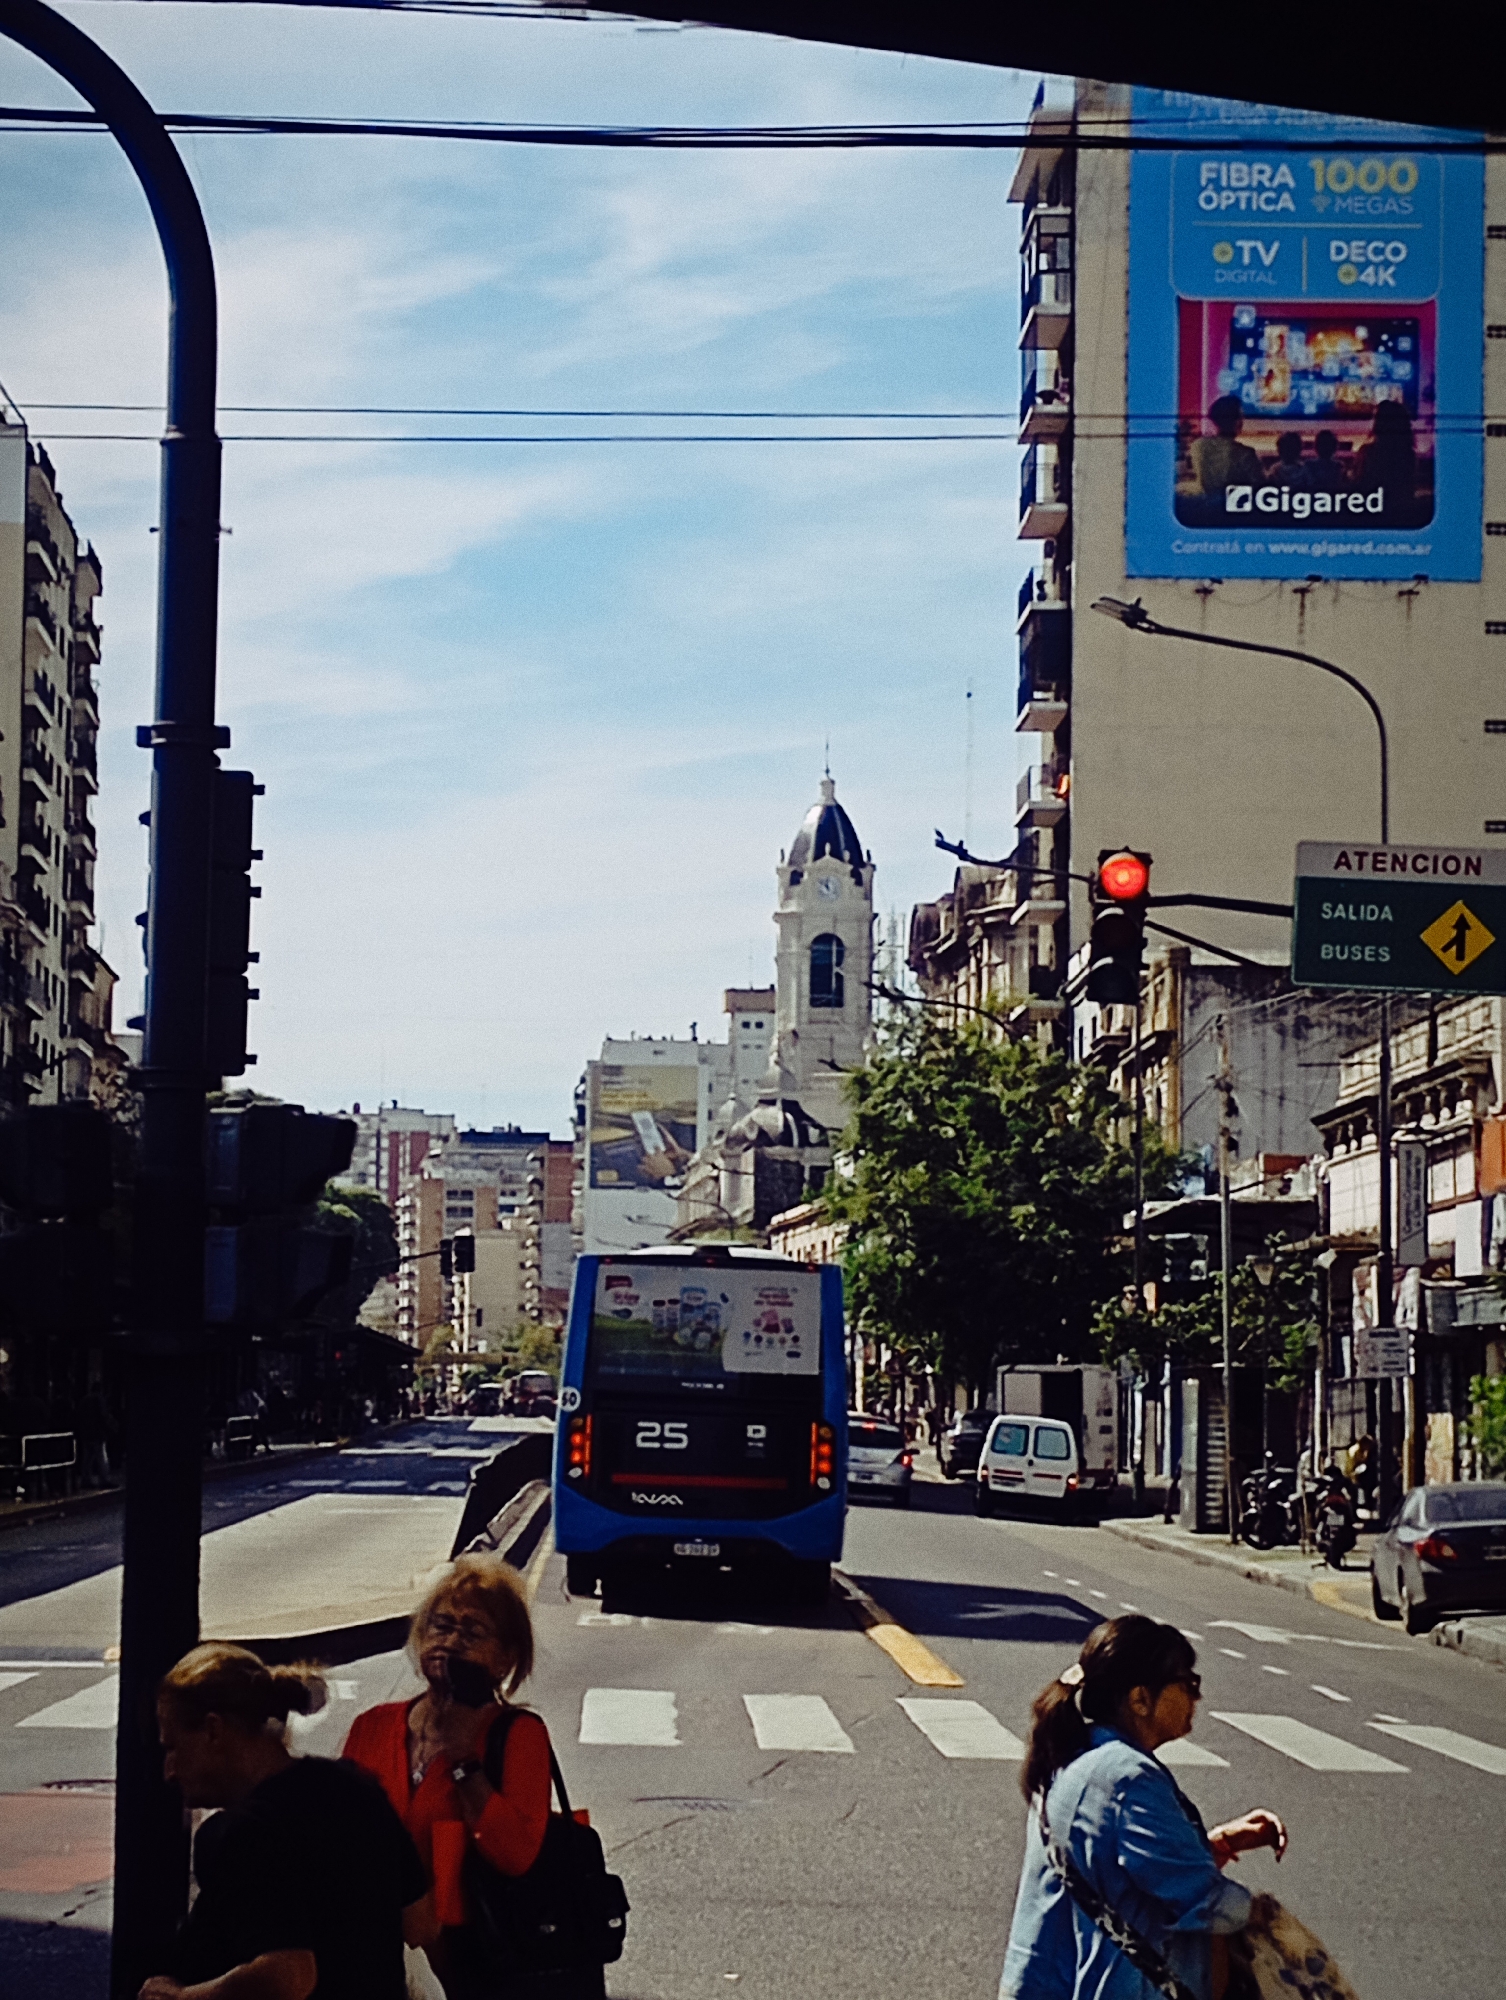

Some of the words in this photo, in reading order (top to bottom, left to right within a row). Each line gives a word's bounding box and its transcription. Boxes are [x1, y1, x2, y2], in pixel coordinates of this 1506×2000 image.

[1200, 162, 1296, 188] FIBRA
[1308, 158, 1419, 194] 1000
[1198, 184, 1296, 212] ÓPTICA
[1334, 196, 1414, 215] MEGAS
[1234, 240, 1280, 266] TV
[1330, 240, 1408, 263] DECO
[1215, 268, 1277, 285] DIGITAL
[1359, 266, 1396, 287] 4K
[1255, 486, 1384, 518] Gigared
[1268, 540, 1432, 557] www.gigared.com.ar
[1333, 850, 1482, 877] ATENCION
[1321, 902, 1394, 922] SALIDA
[1320, 944, 1391, 963] BUSES
[636, 1421, 688, 1449] 25
